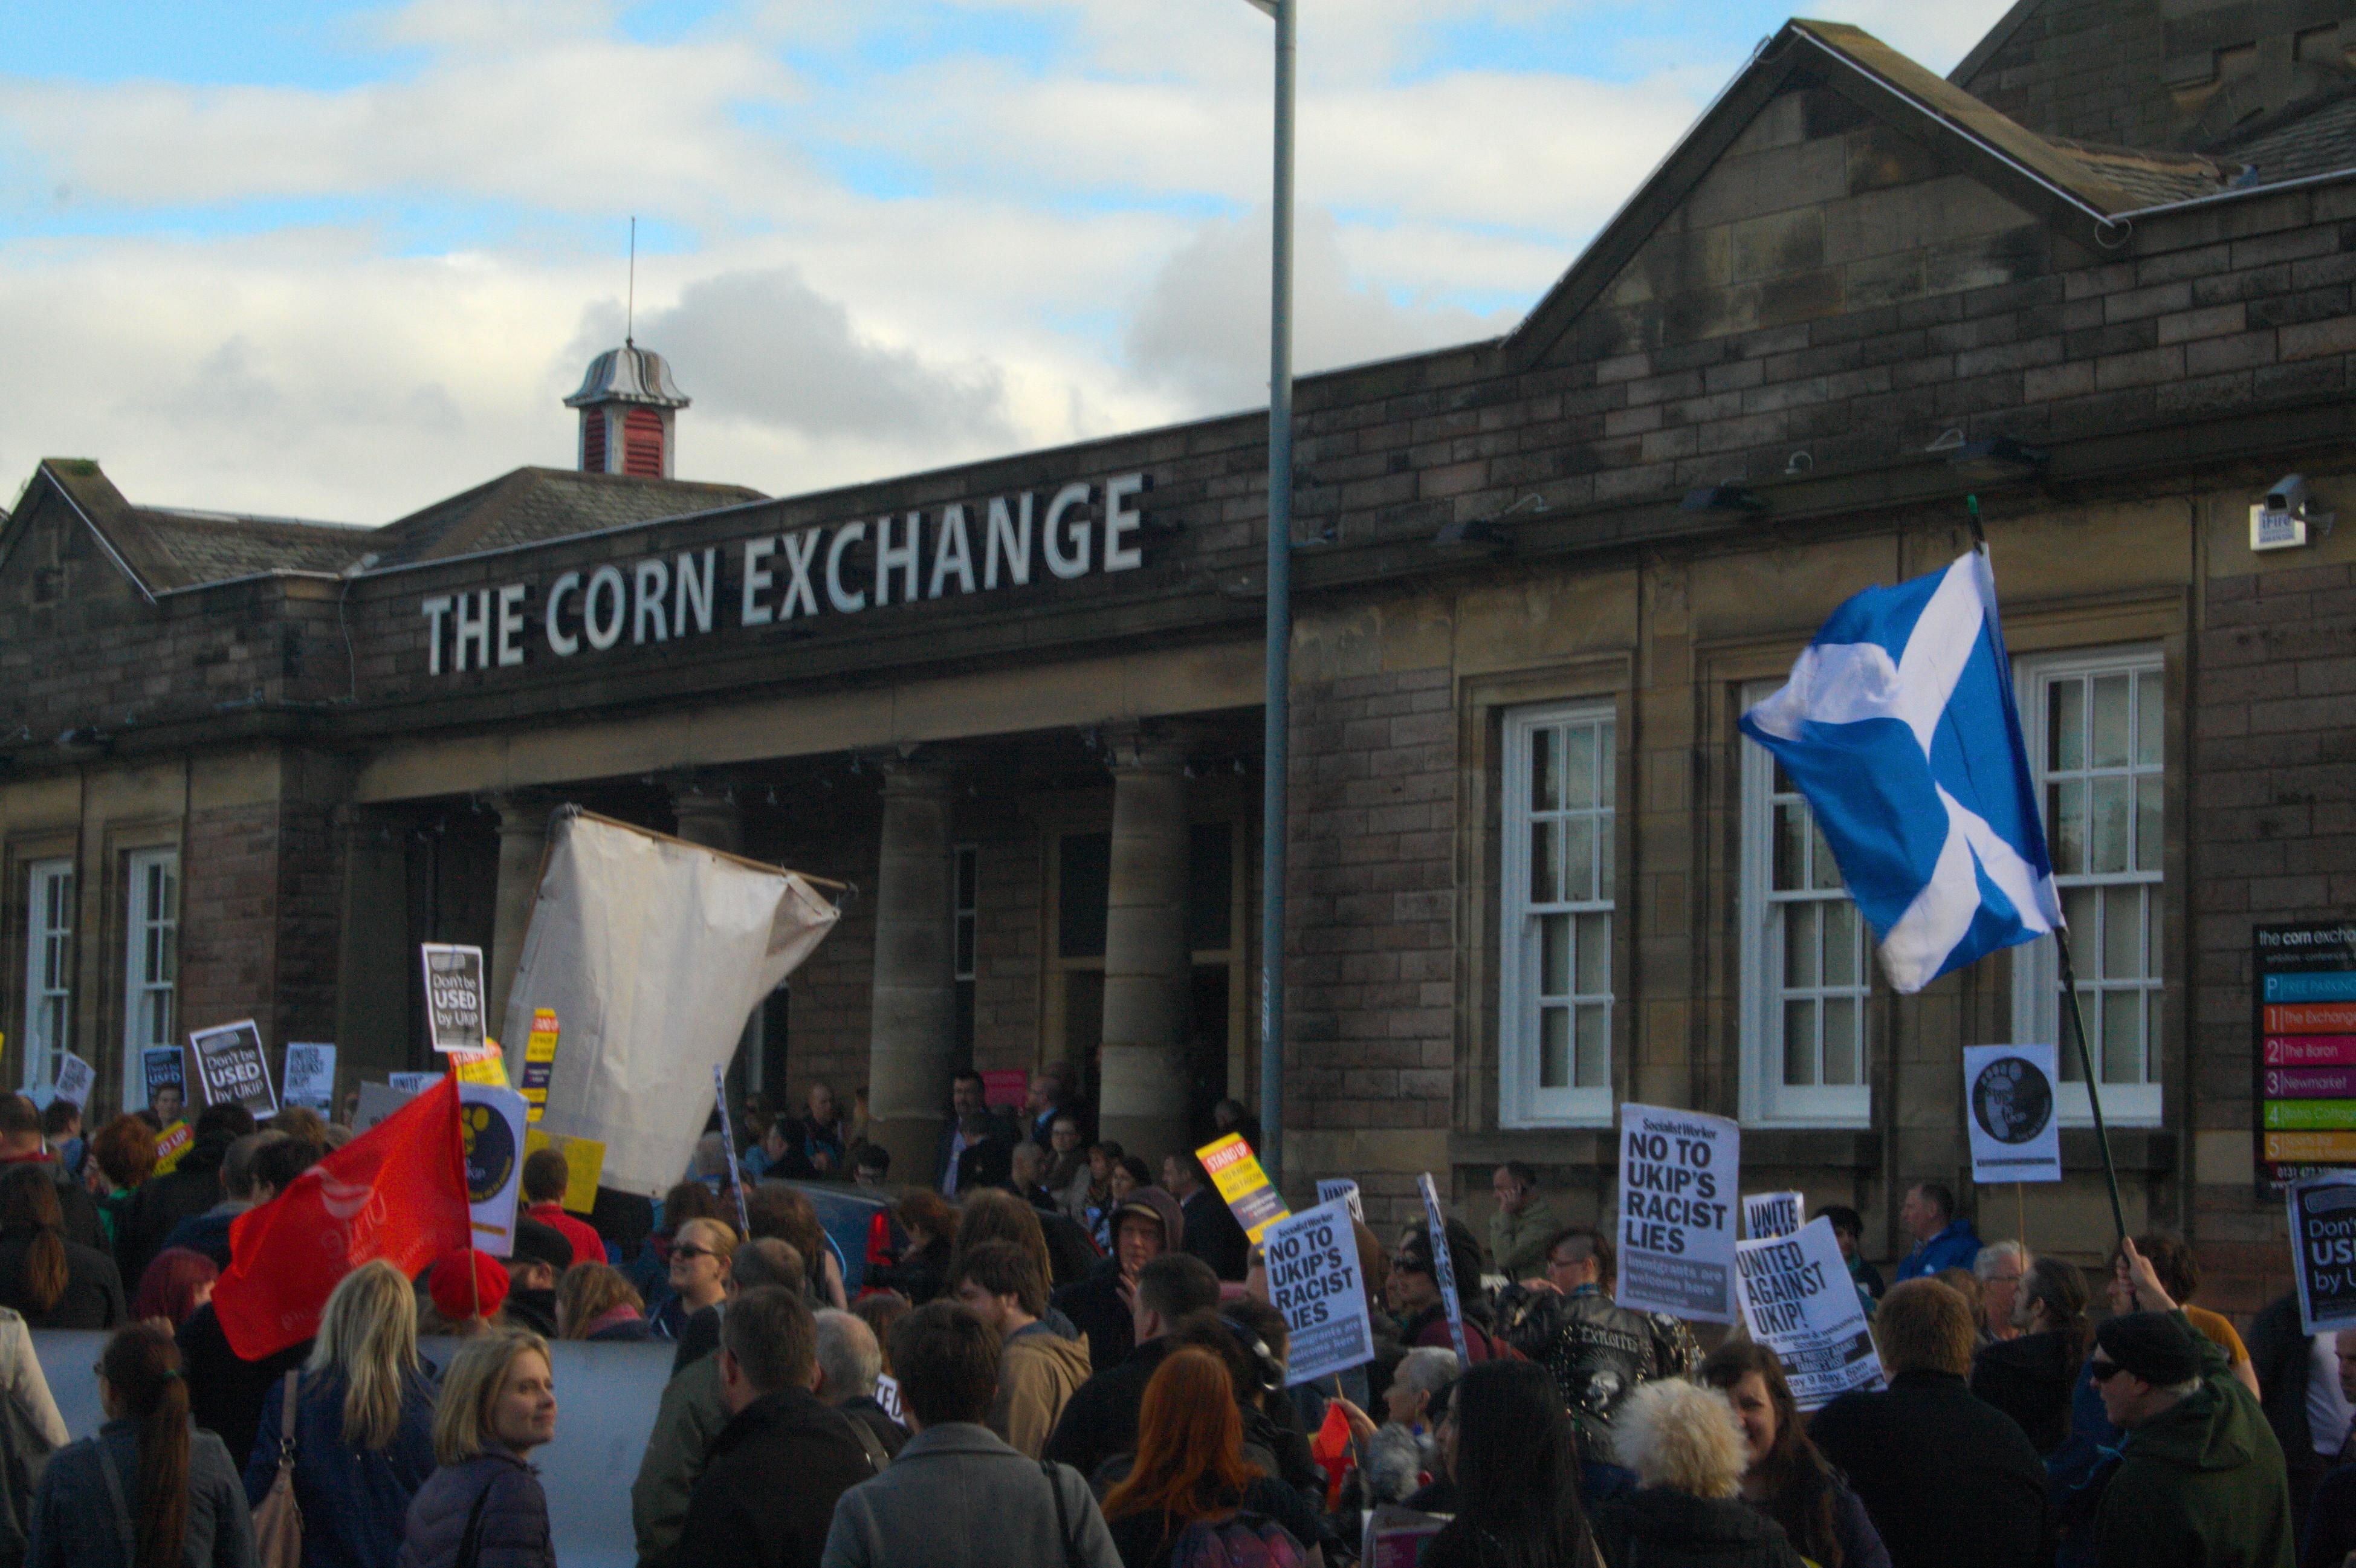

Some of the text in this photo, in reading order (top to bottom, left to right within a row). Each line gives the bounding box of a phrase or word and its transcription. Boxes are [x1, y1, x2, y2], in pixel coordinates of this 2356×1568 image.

[422, 474, 1144, 676] THE CORN EXCHANGE
[2259, 930, 2280, 946] the
[2282, 930, 2312, 945] corn
[433, 974, 476, 990] Don't be
[2267, 977, 2277, 999] P
[2283, 980, 2308, 994] FREE
[434, 990, 476, 1009] USED
[437, 1010, 478, 1028] by UKIP
[2270, 1008, 2277, 1031] 1
[2284, 1010, 2303, 1024] The
[207, 1049, 256, 1070] Don't be
[2267, 1040, 2338, 1063] 2 The Baron
[149, 1072, 180, 1084] USED
[210, 1062, 261, 1088] USED
[2267, 1072, 2347, 1095] 3 Newmarket
[215, 1080, 264, 1103] by UKIP
[2268, 1106, 2279, 1125] 4
[1643, 1118, 1717, 1140] Socialist Worker
[1206, 1141, 1248, 1172] STAND UP
[1628, 1130, 1712, 1168] NO TO
[2269, 1136, 2280, 1158] 5
[1232, 1162, 1253, 1178] RACISM
[1627, 1161, 1716, 1199] UKIP'S
[1226, 1184, 1240, 1194] AND
[1626, 1189, 1727, 1231] RACIST
[1750, 1199, 1796, 1229] UNITE
[1270, 1225, 1333, 1265] NO TO
[1625, 1220, 1684, 1255] LIES
[1272, 1247, 1342, 1288] UKIP'S
[1736, 1241, 1805, 1278] UNITED
[1628, 1272, 1715, 1297] welcome here
[1701, 1269, 1723, 1283] are
[1746, 1261, 1827, 1307] AGAINST
[2314, 1269, 2341, 1295] by
[1275, 1266, 1354, 1310] RACIST
[1289, 1301, 1328, 1332] IES
[1752, 1301, 1809, 1335] UKIP!
[1289, 1320, 1360, 1350] mmigrants are
[1334, 1334, 1357, 1348] here
[1808, 1375, 1816, 1384] 9
